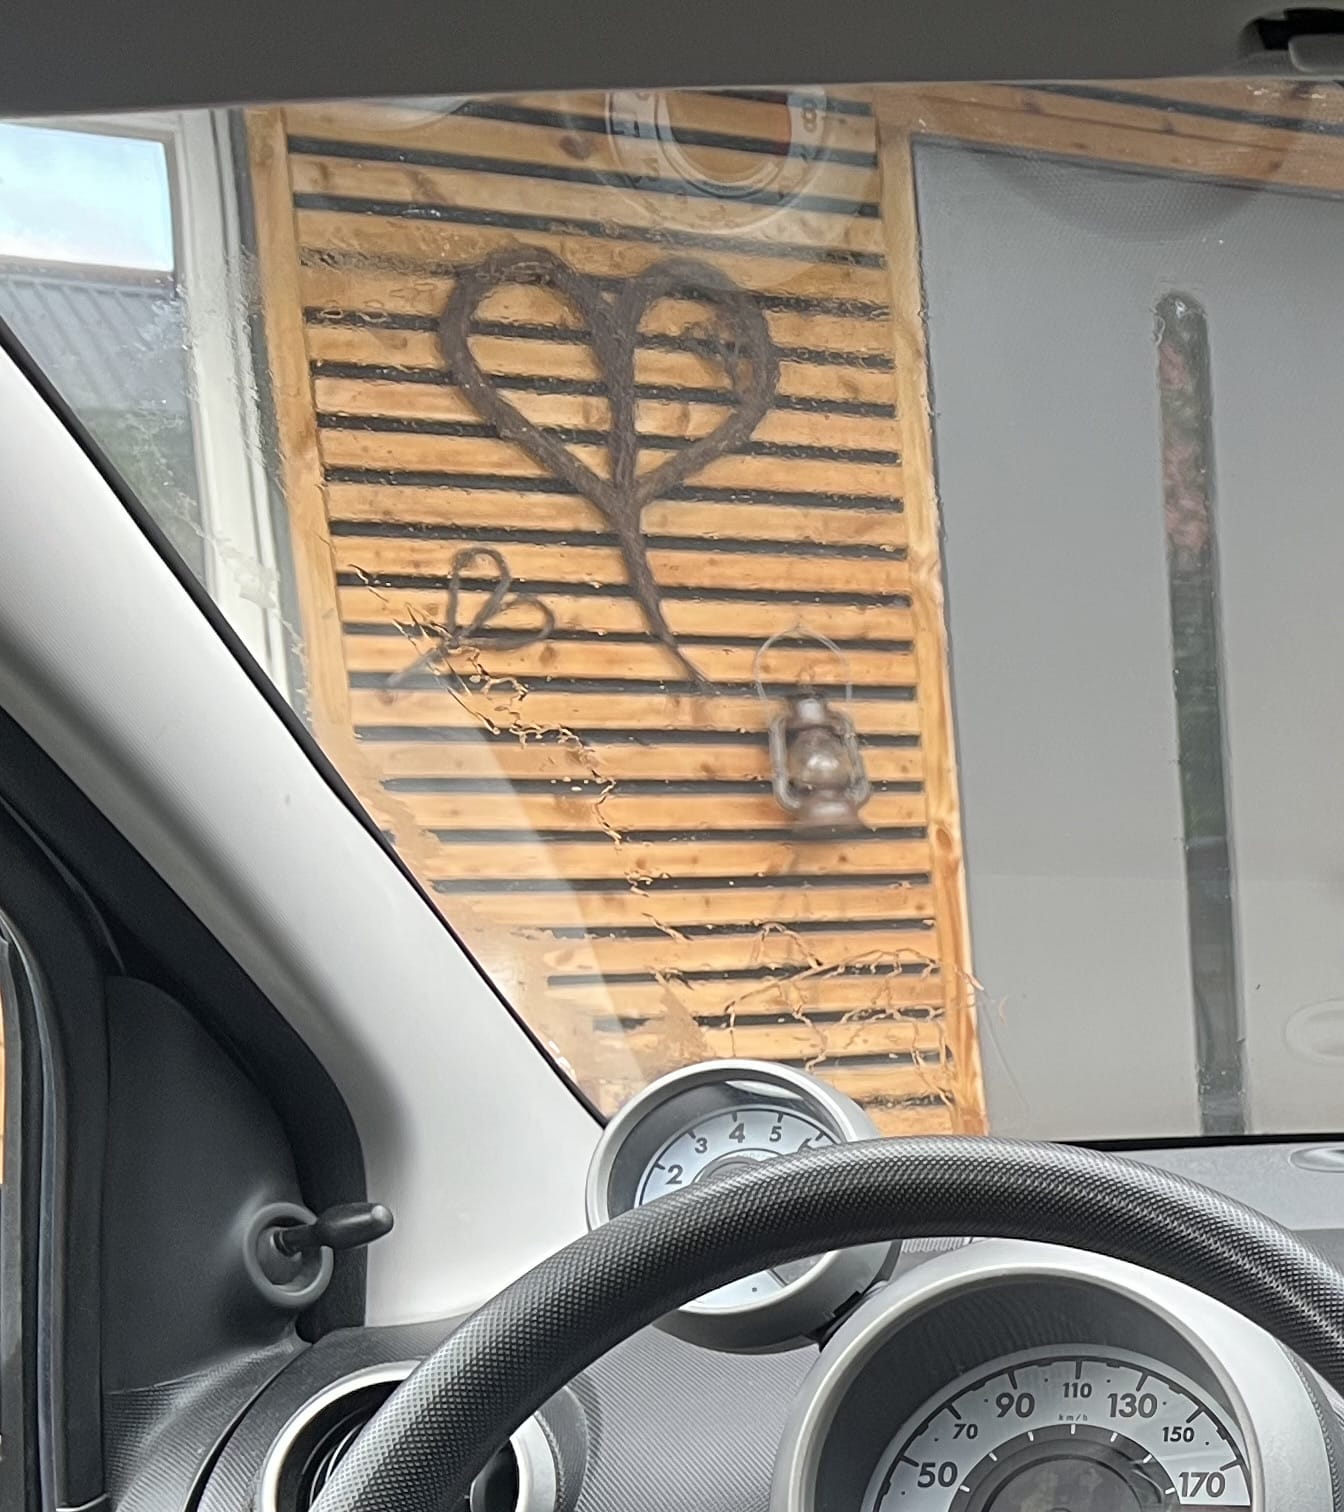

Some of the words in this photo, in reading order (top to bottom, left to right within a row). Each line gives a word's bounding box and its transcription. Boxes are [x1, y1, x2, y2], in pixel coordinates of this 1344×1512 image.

[665, 1164, 683, 1185] 2
[694, 1137, 708, 1154] 3
[728, 1122, 746, 1143] 4
[769, 1125, 782, 1142] 5
[917, 1461, 958, 1488] 50
[952, 1423, 979, 1440] 70
[995, 1392, 1035, 1418] 90
[1062, 1382, 1092, 1398] 110
[1106, 1392, 1158, 1418] 130
[1161, 1426, 1195, 1443] 150
[1178, 1471, 1226, 1498] 170
